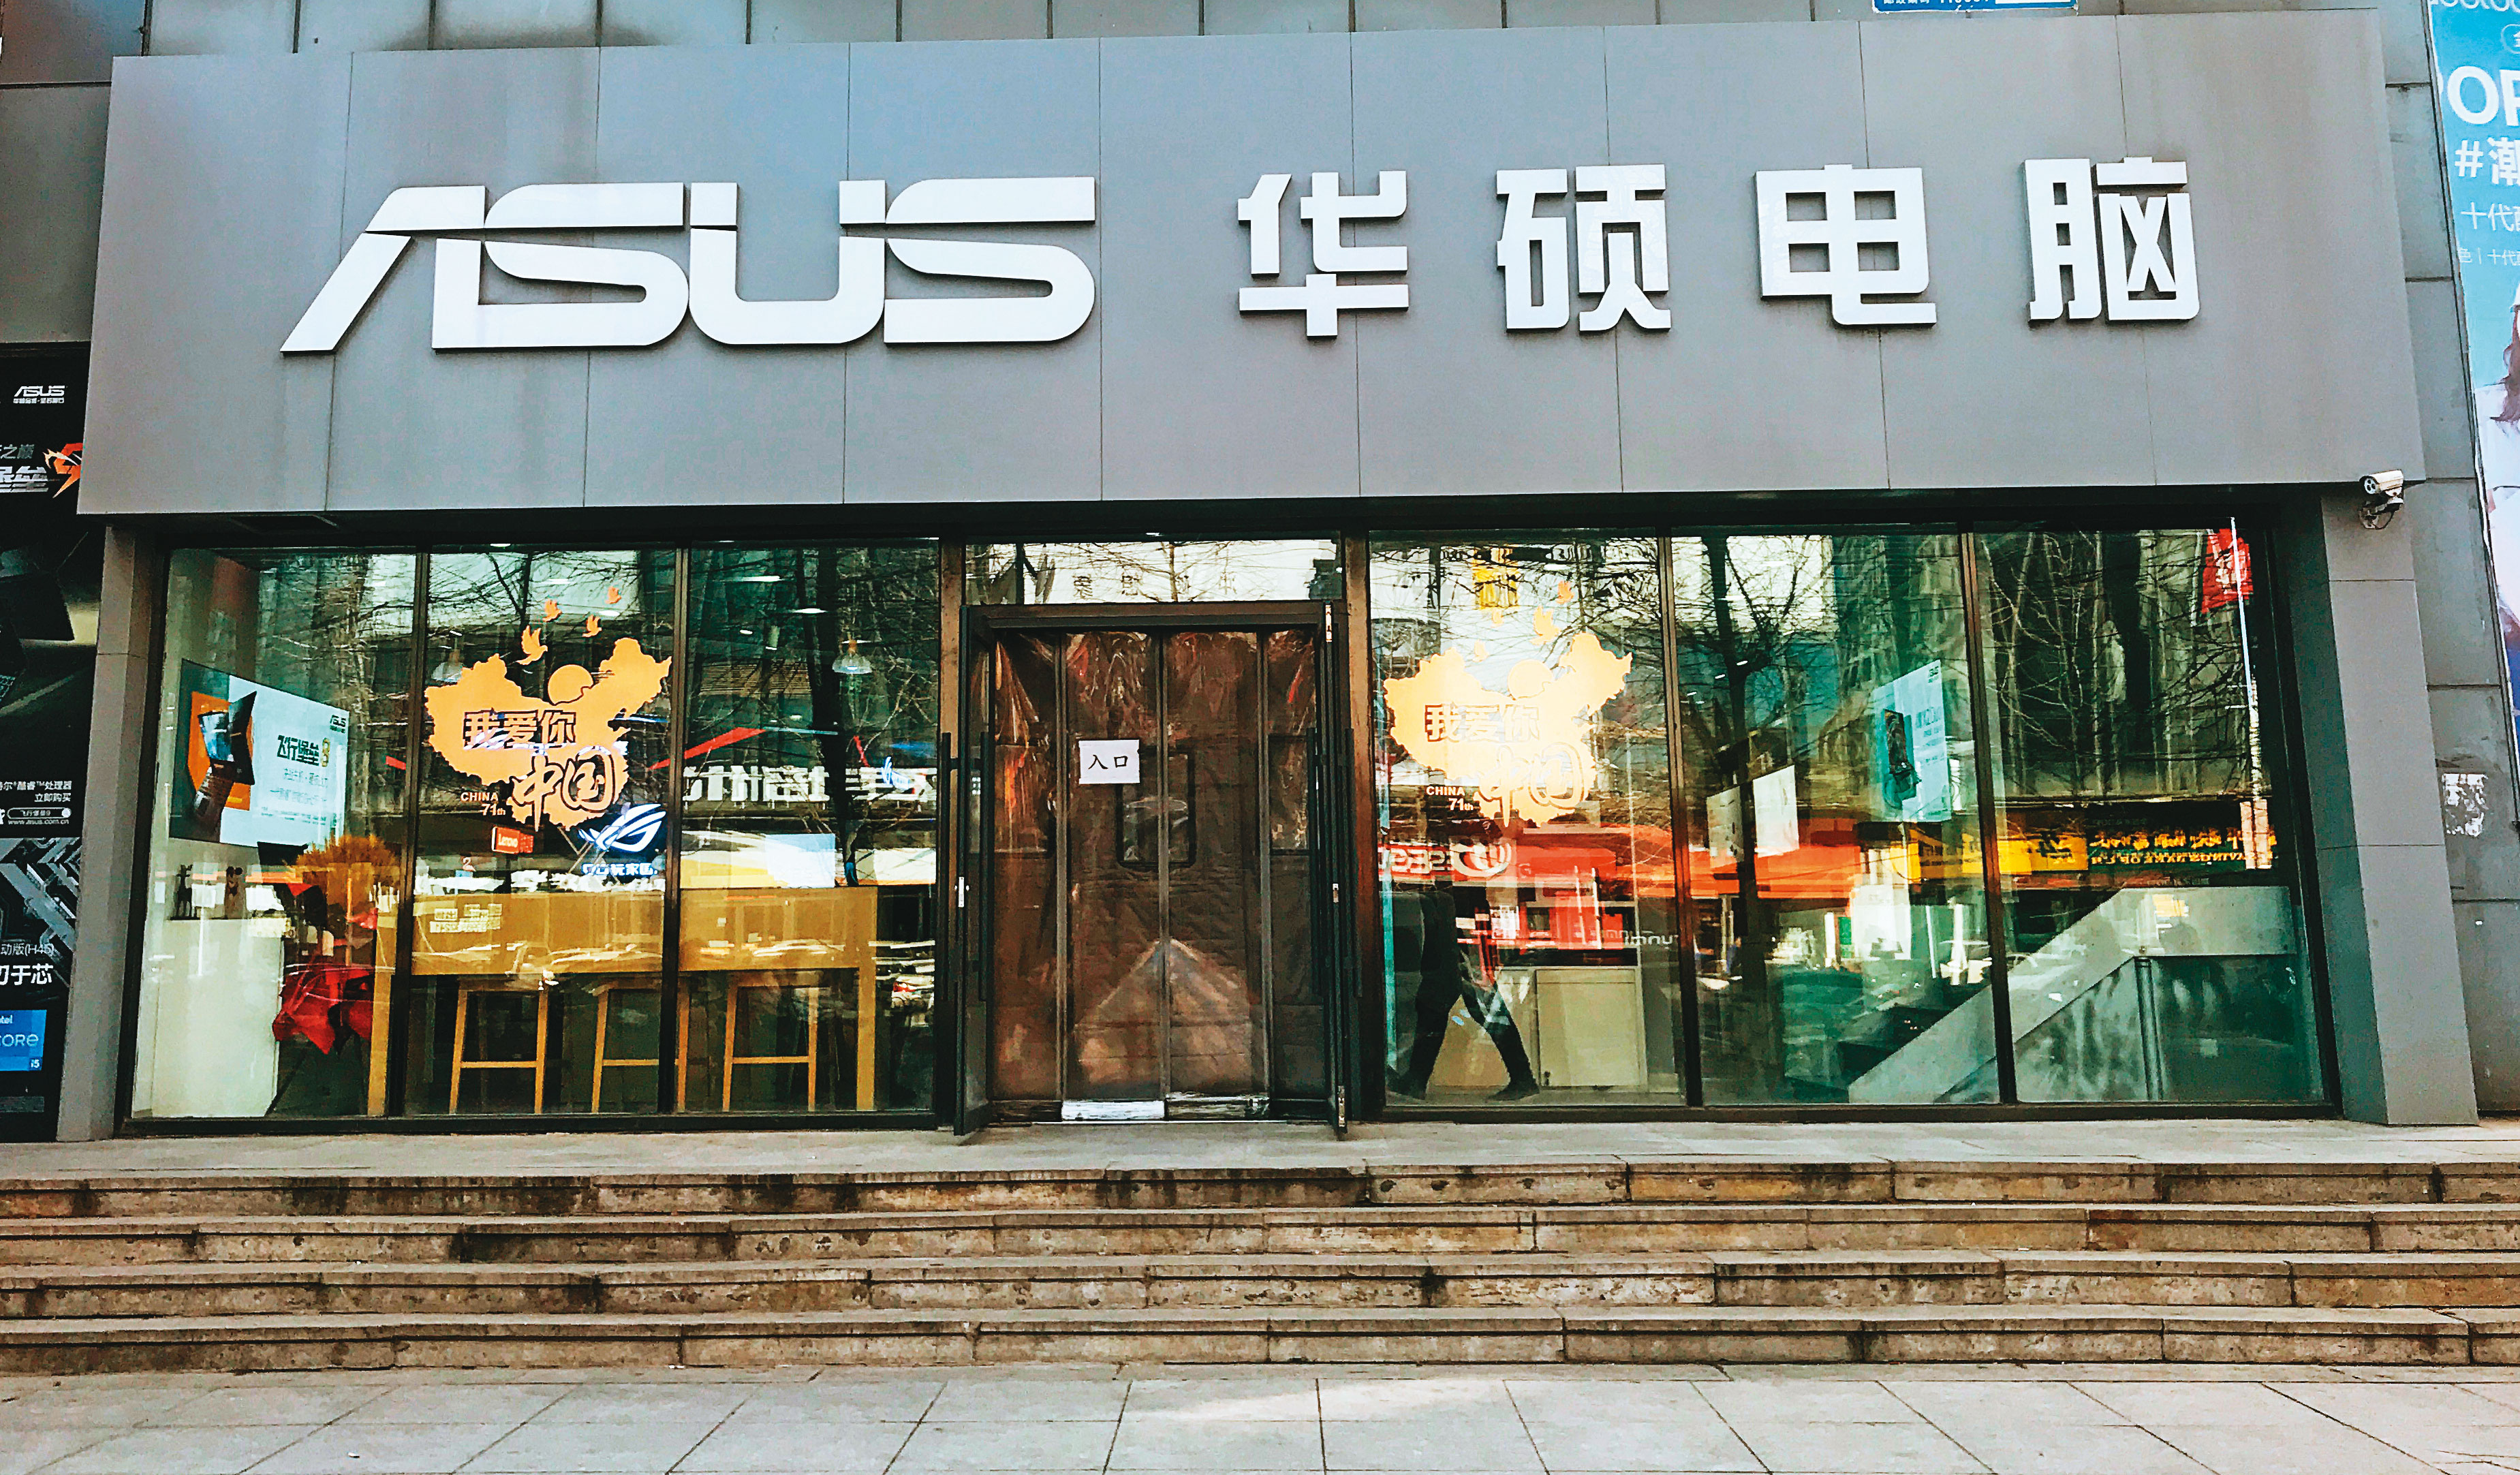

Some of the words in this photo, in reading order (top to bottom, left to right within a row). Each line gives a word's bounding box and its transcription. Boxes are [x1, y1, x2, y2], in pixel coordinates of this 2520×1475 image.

[1238, 157, 2201, 338] 华硕电脑
[280, 176, 1095, 353] ASUS
[14, 386, 65, 397] ASUS
[464, 710, 576, 749] 我爱你
[1425, 706, 1540, 742] 我爱你
[1088, 754, 1128, 770] 入口
[461, 792, 499, 802] CHINA
[512, 746, 615, 832] 中国
[1426, 786, 1465, 796] CHINA
[1478, 743, 1584, 827] 中国
[481, 803, 506, 816] 71th
[1448, 798, 1474, 811] 71th
